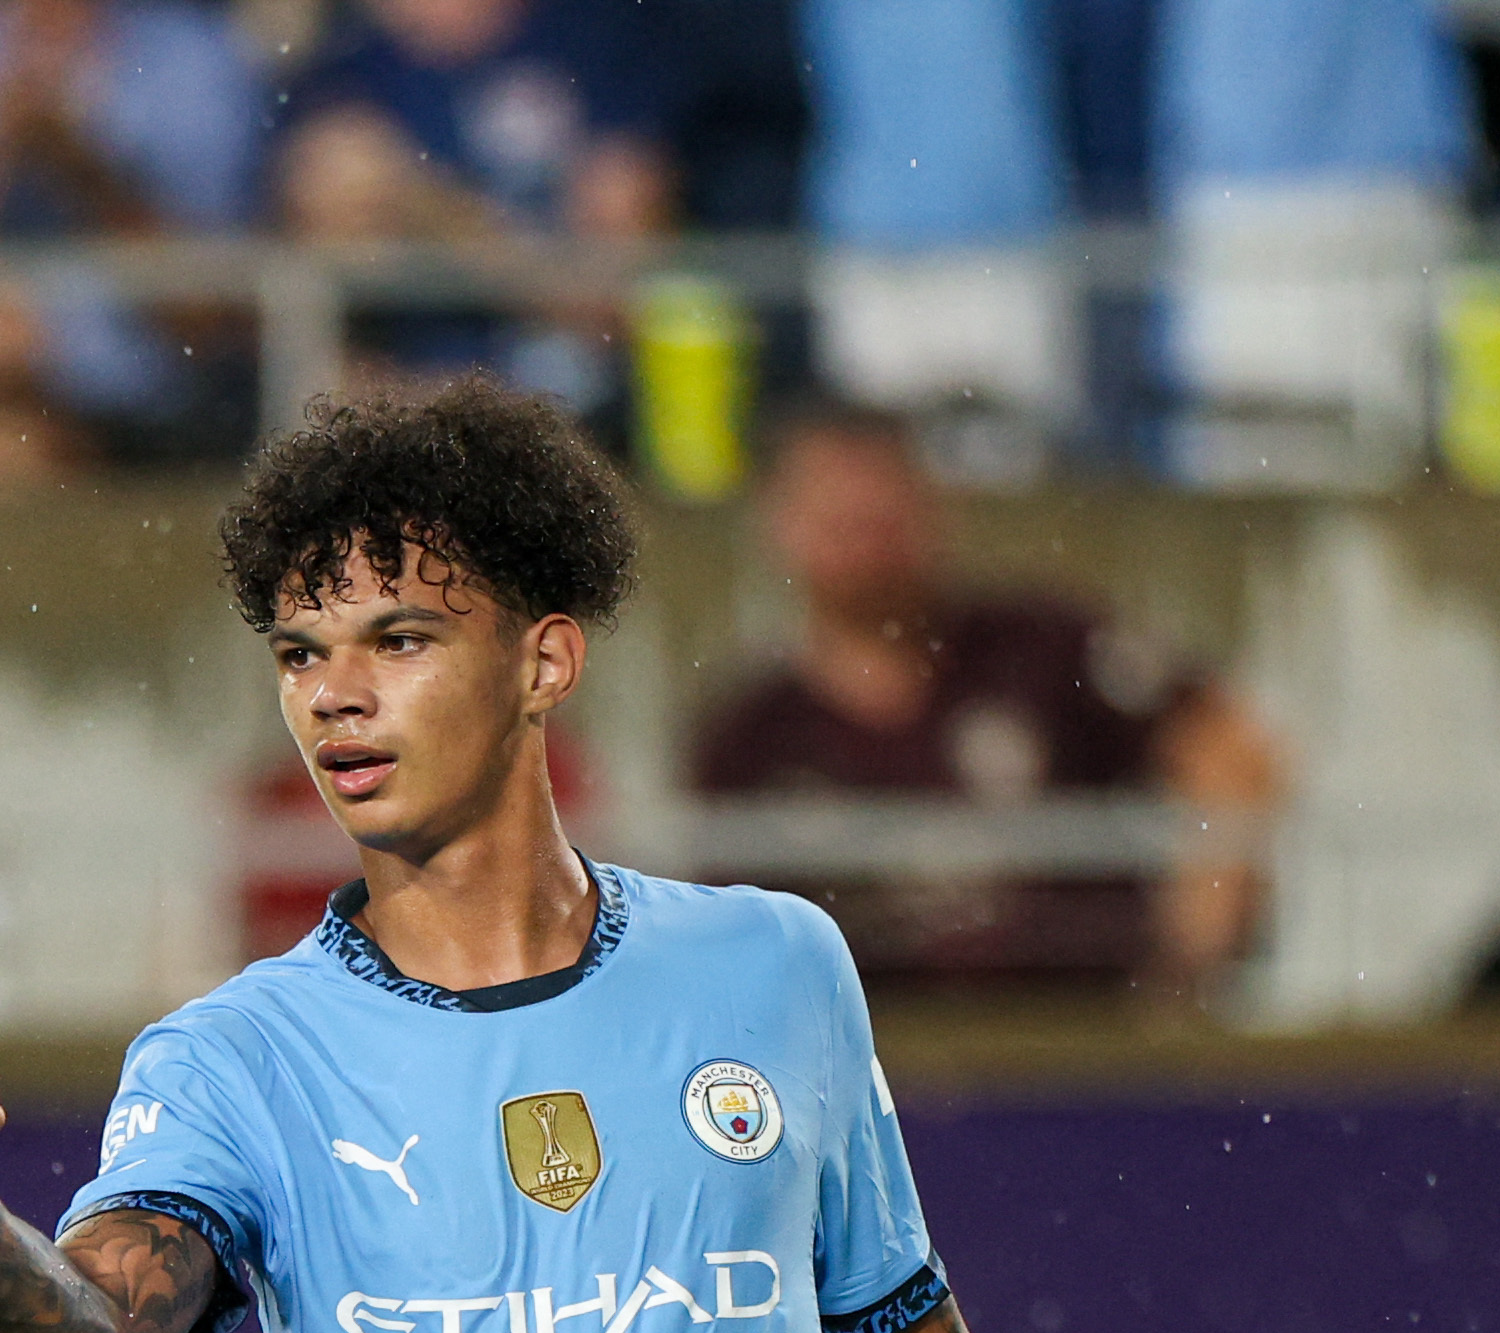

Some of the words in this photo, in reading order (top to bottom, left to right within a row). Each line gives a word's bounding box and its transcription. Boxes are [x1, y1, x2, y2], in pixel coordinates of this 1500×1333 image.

[691, 1066, 770, 1099] MANCHESTER
[730, 1146, 758, 1156] CITY
[538, 1165, 580, 1186] FIFA
[551, 1188, 575, 1200] 2023
